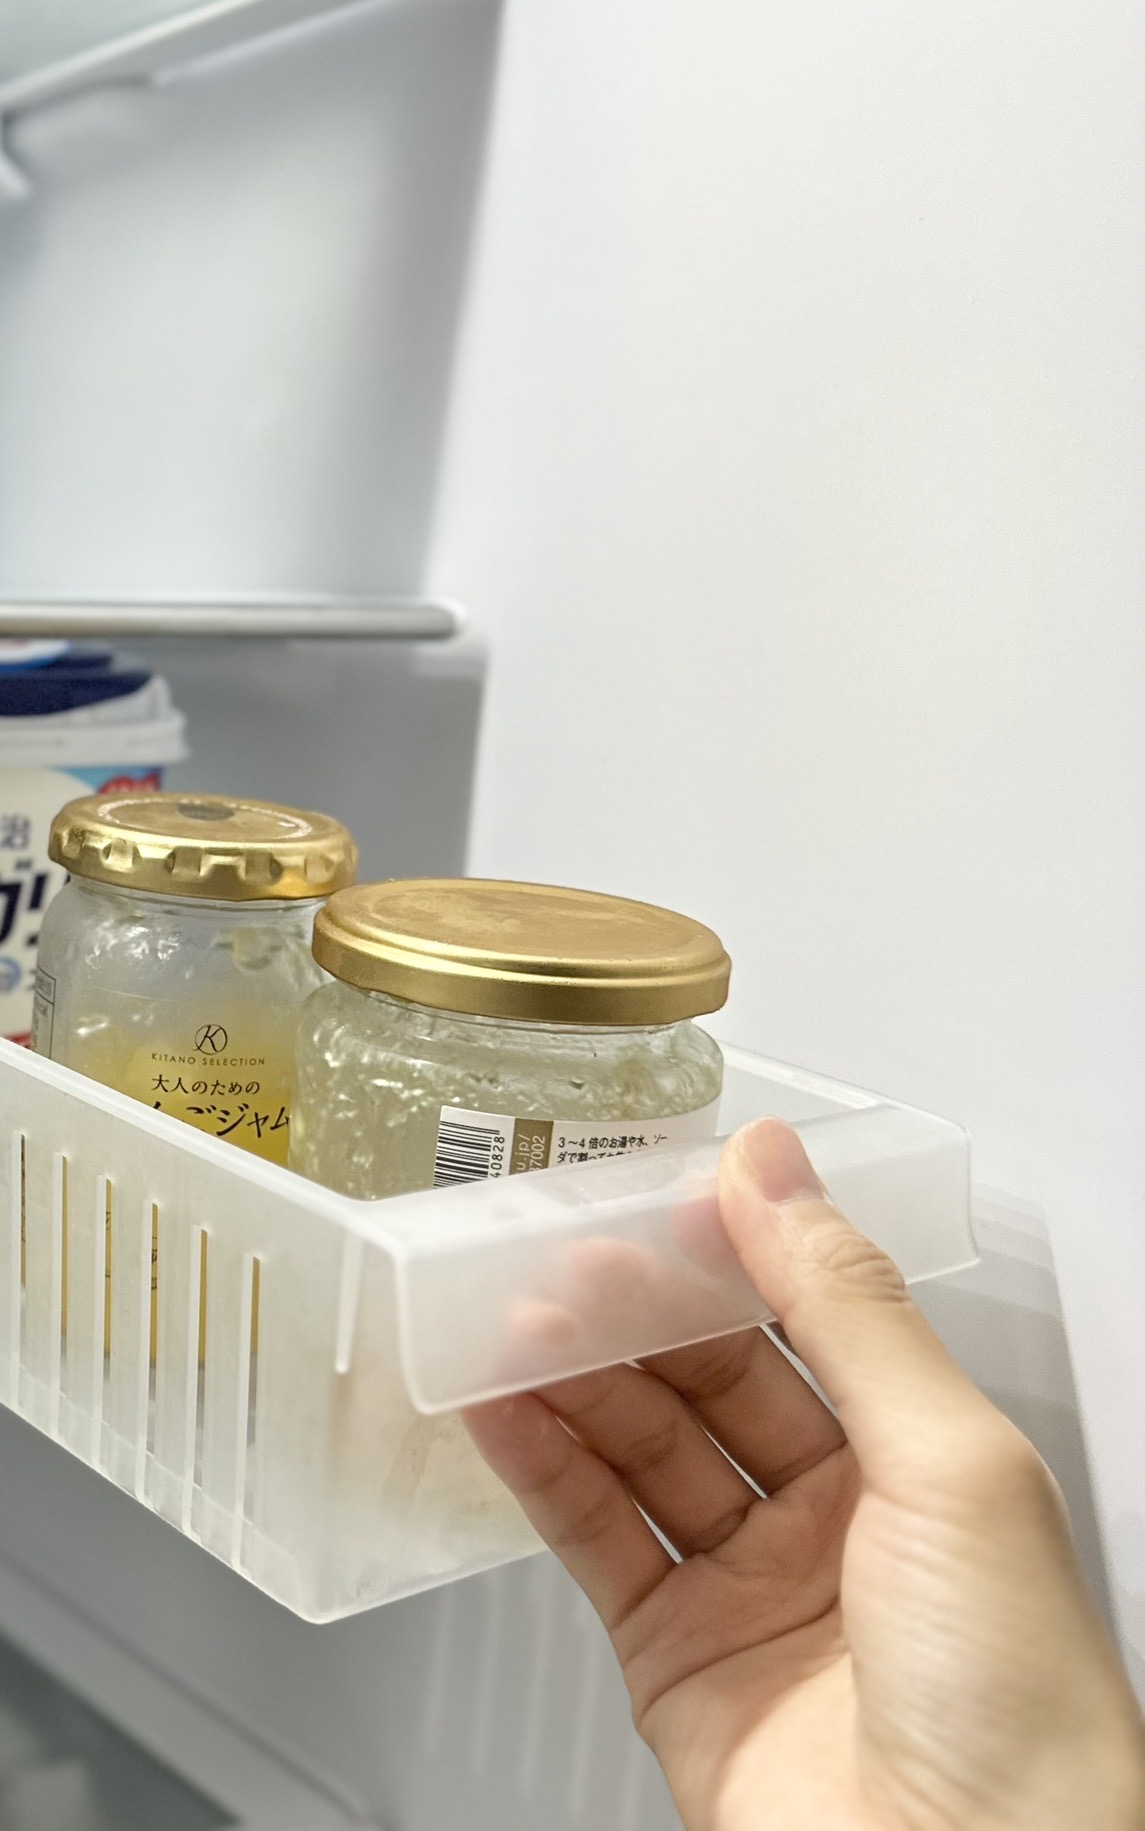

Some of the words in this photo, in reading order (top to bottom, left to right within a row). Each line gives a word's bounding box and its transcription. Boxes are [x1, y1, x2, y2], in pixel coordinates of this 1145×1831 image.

[151, 1052, 196, 1065] KITANO
[202, 1057, 265, 1067] SELECTION
[150, 1073, 260, 1096] 大人のための
